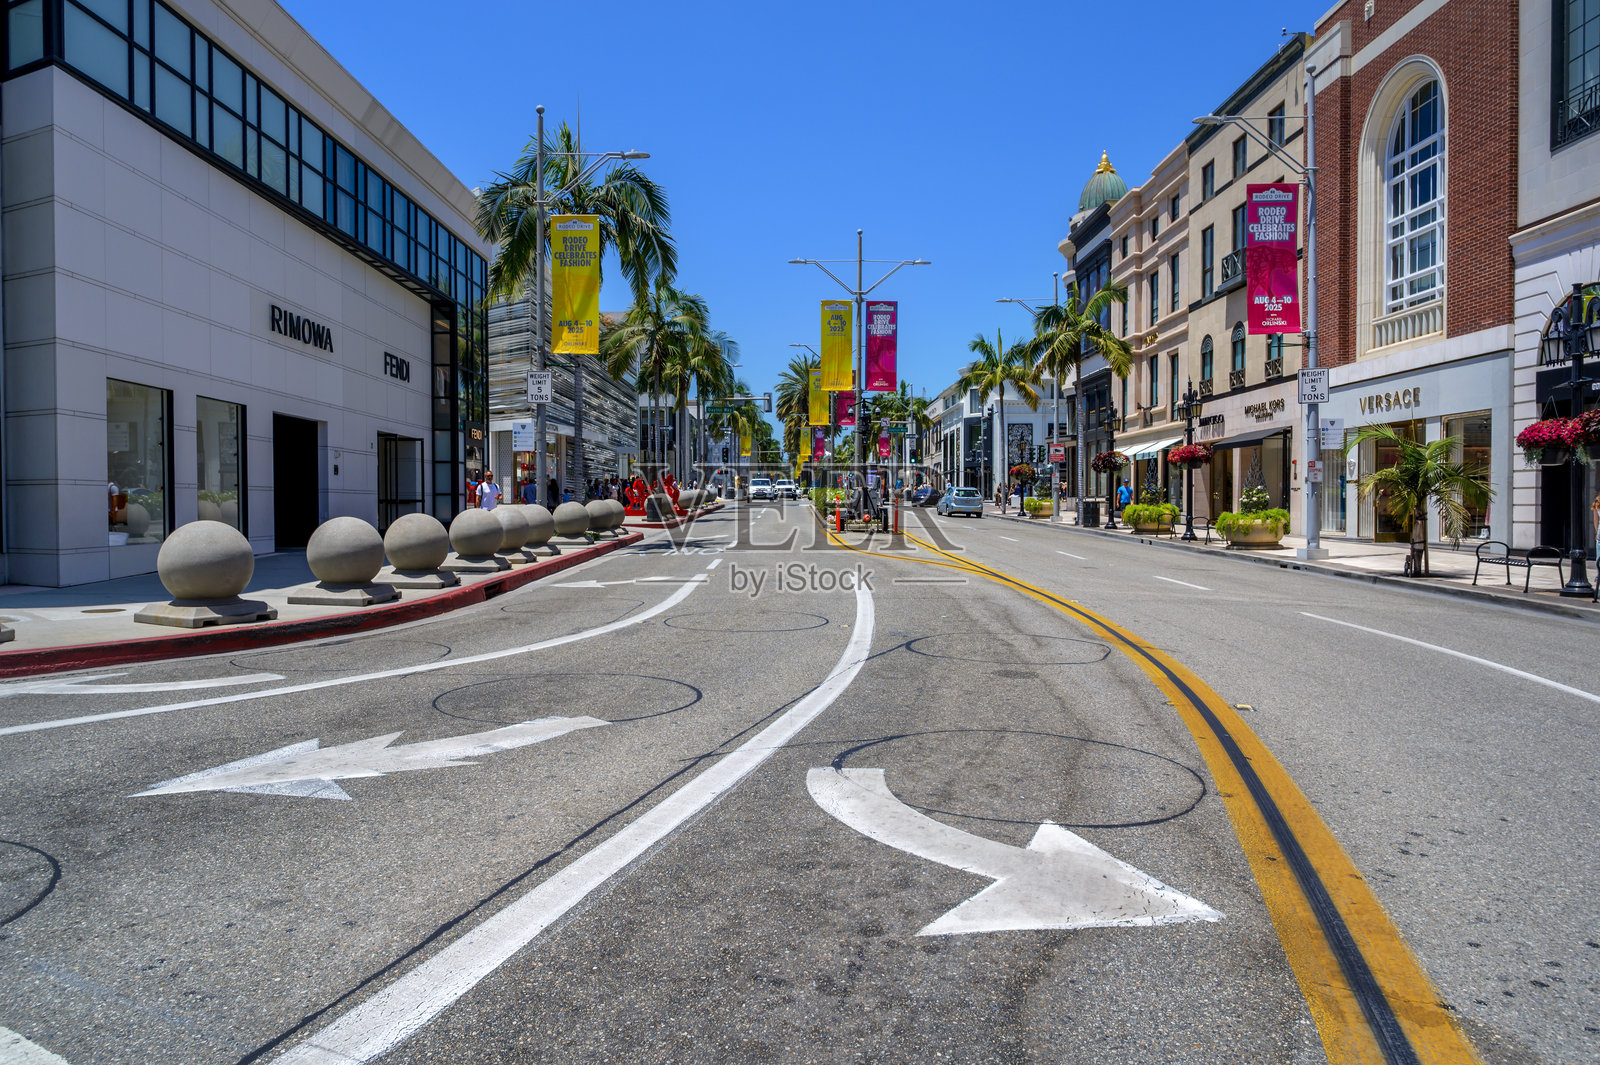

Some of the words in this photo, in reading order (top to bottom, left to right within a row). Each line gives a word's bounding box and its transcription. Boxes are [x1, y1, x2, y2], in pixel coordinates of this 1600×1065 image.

[1258, 206, 1286, 216] RODEO
[1260, 216, 1284, 224] DRIVE
[1248, 224, 1295, 232] CELEBRATES
[1254, 232, 1289, 240] FASHION
[271, 304, 334, 352] RIMOWA
[384, 352, 410, 382] FENDI
[1244, 402, 1267, 414] MICHAEL
[1269, 398, 1285, 409] KORS
[1360, 387, 1420, 414] VERSACE
